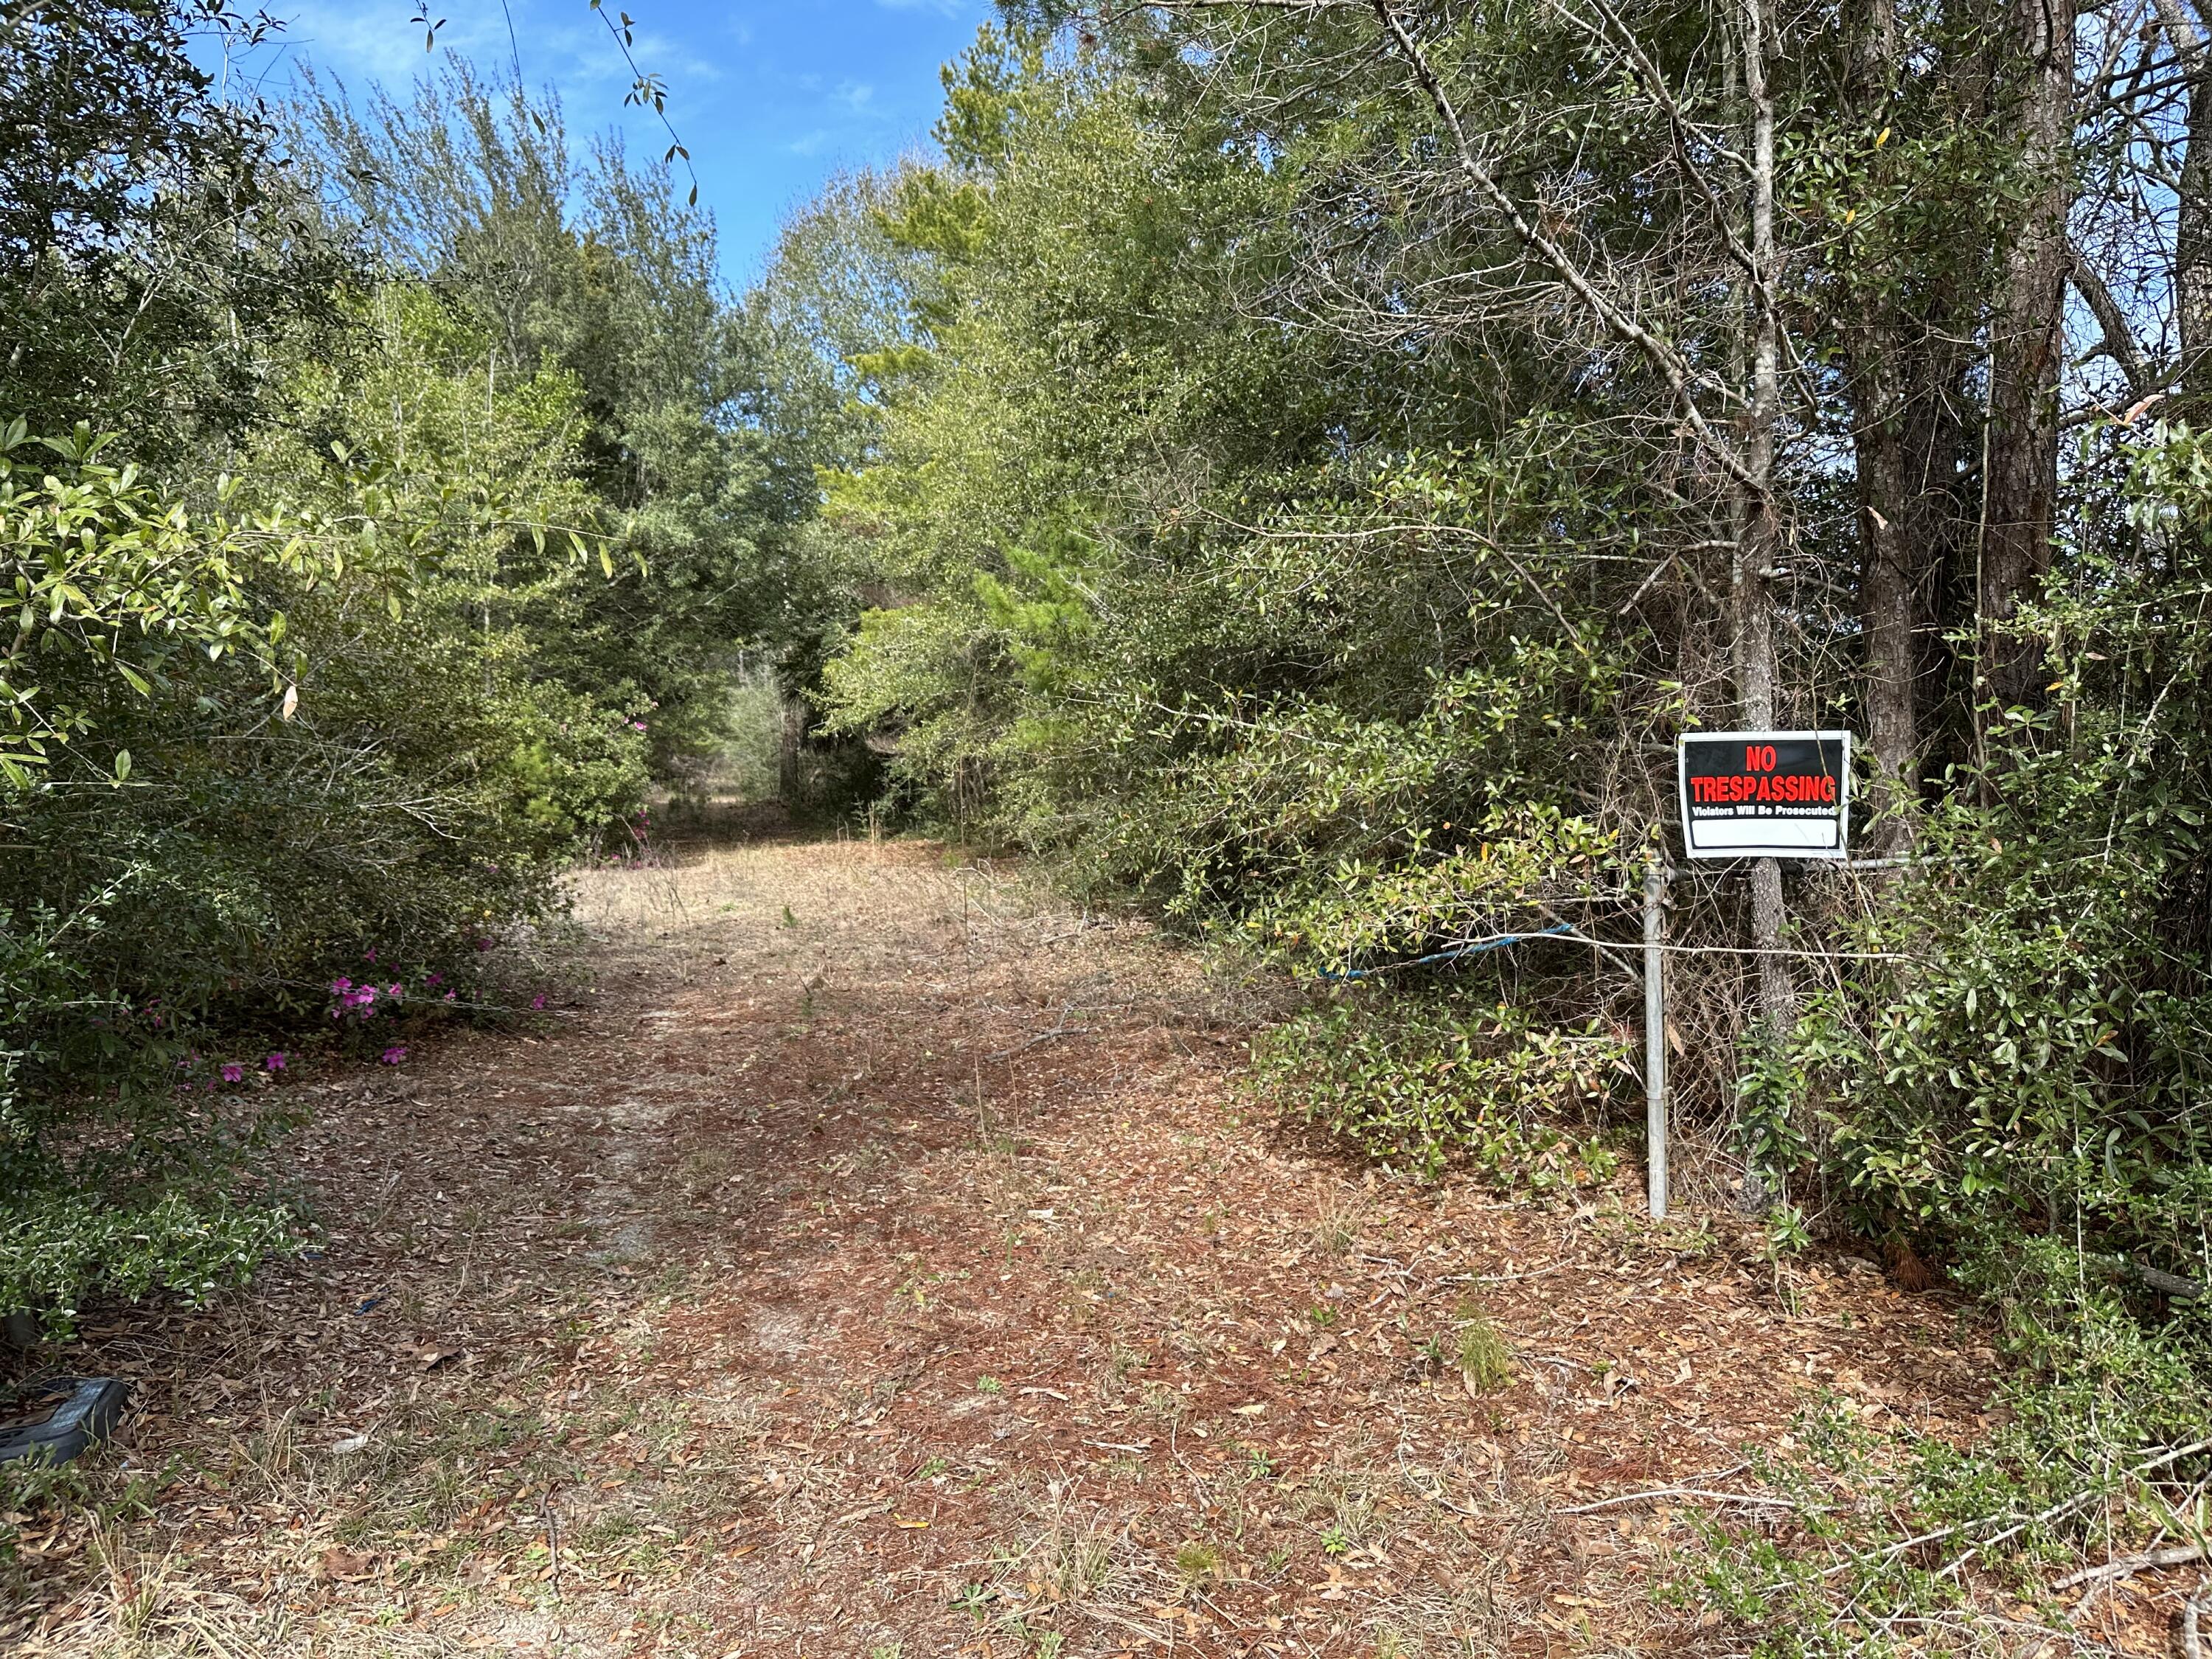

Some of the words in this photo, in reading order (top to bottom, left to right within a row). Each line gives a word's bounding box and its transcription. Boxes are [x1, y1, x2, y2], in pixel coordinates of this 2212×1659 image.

[1746, 745, 1776, 772] NO
[1691, 775, 1836, 802] TRESPASSING
[1692, 806, 1733, 816] Violators
[1736, 805, 1755, 815] Will
[1758, 805, 1772, 815] Be
[1775, 805, 1835, 815] Prosecuted
